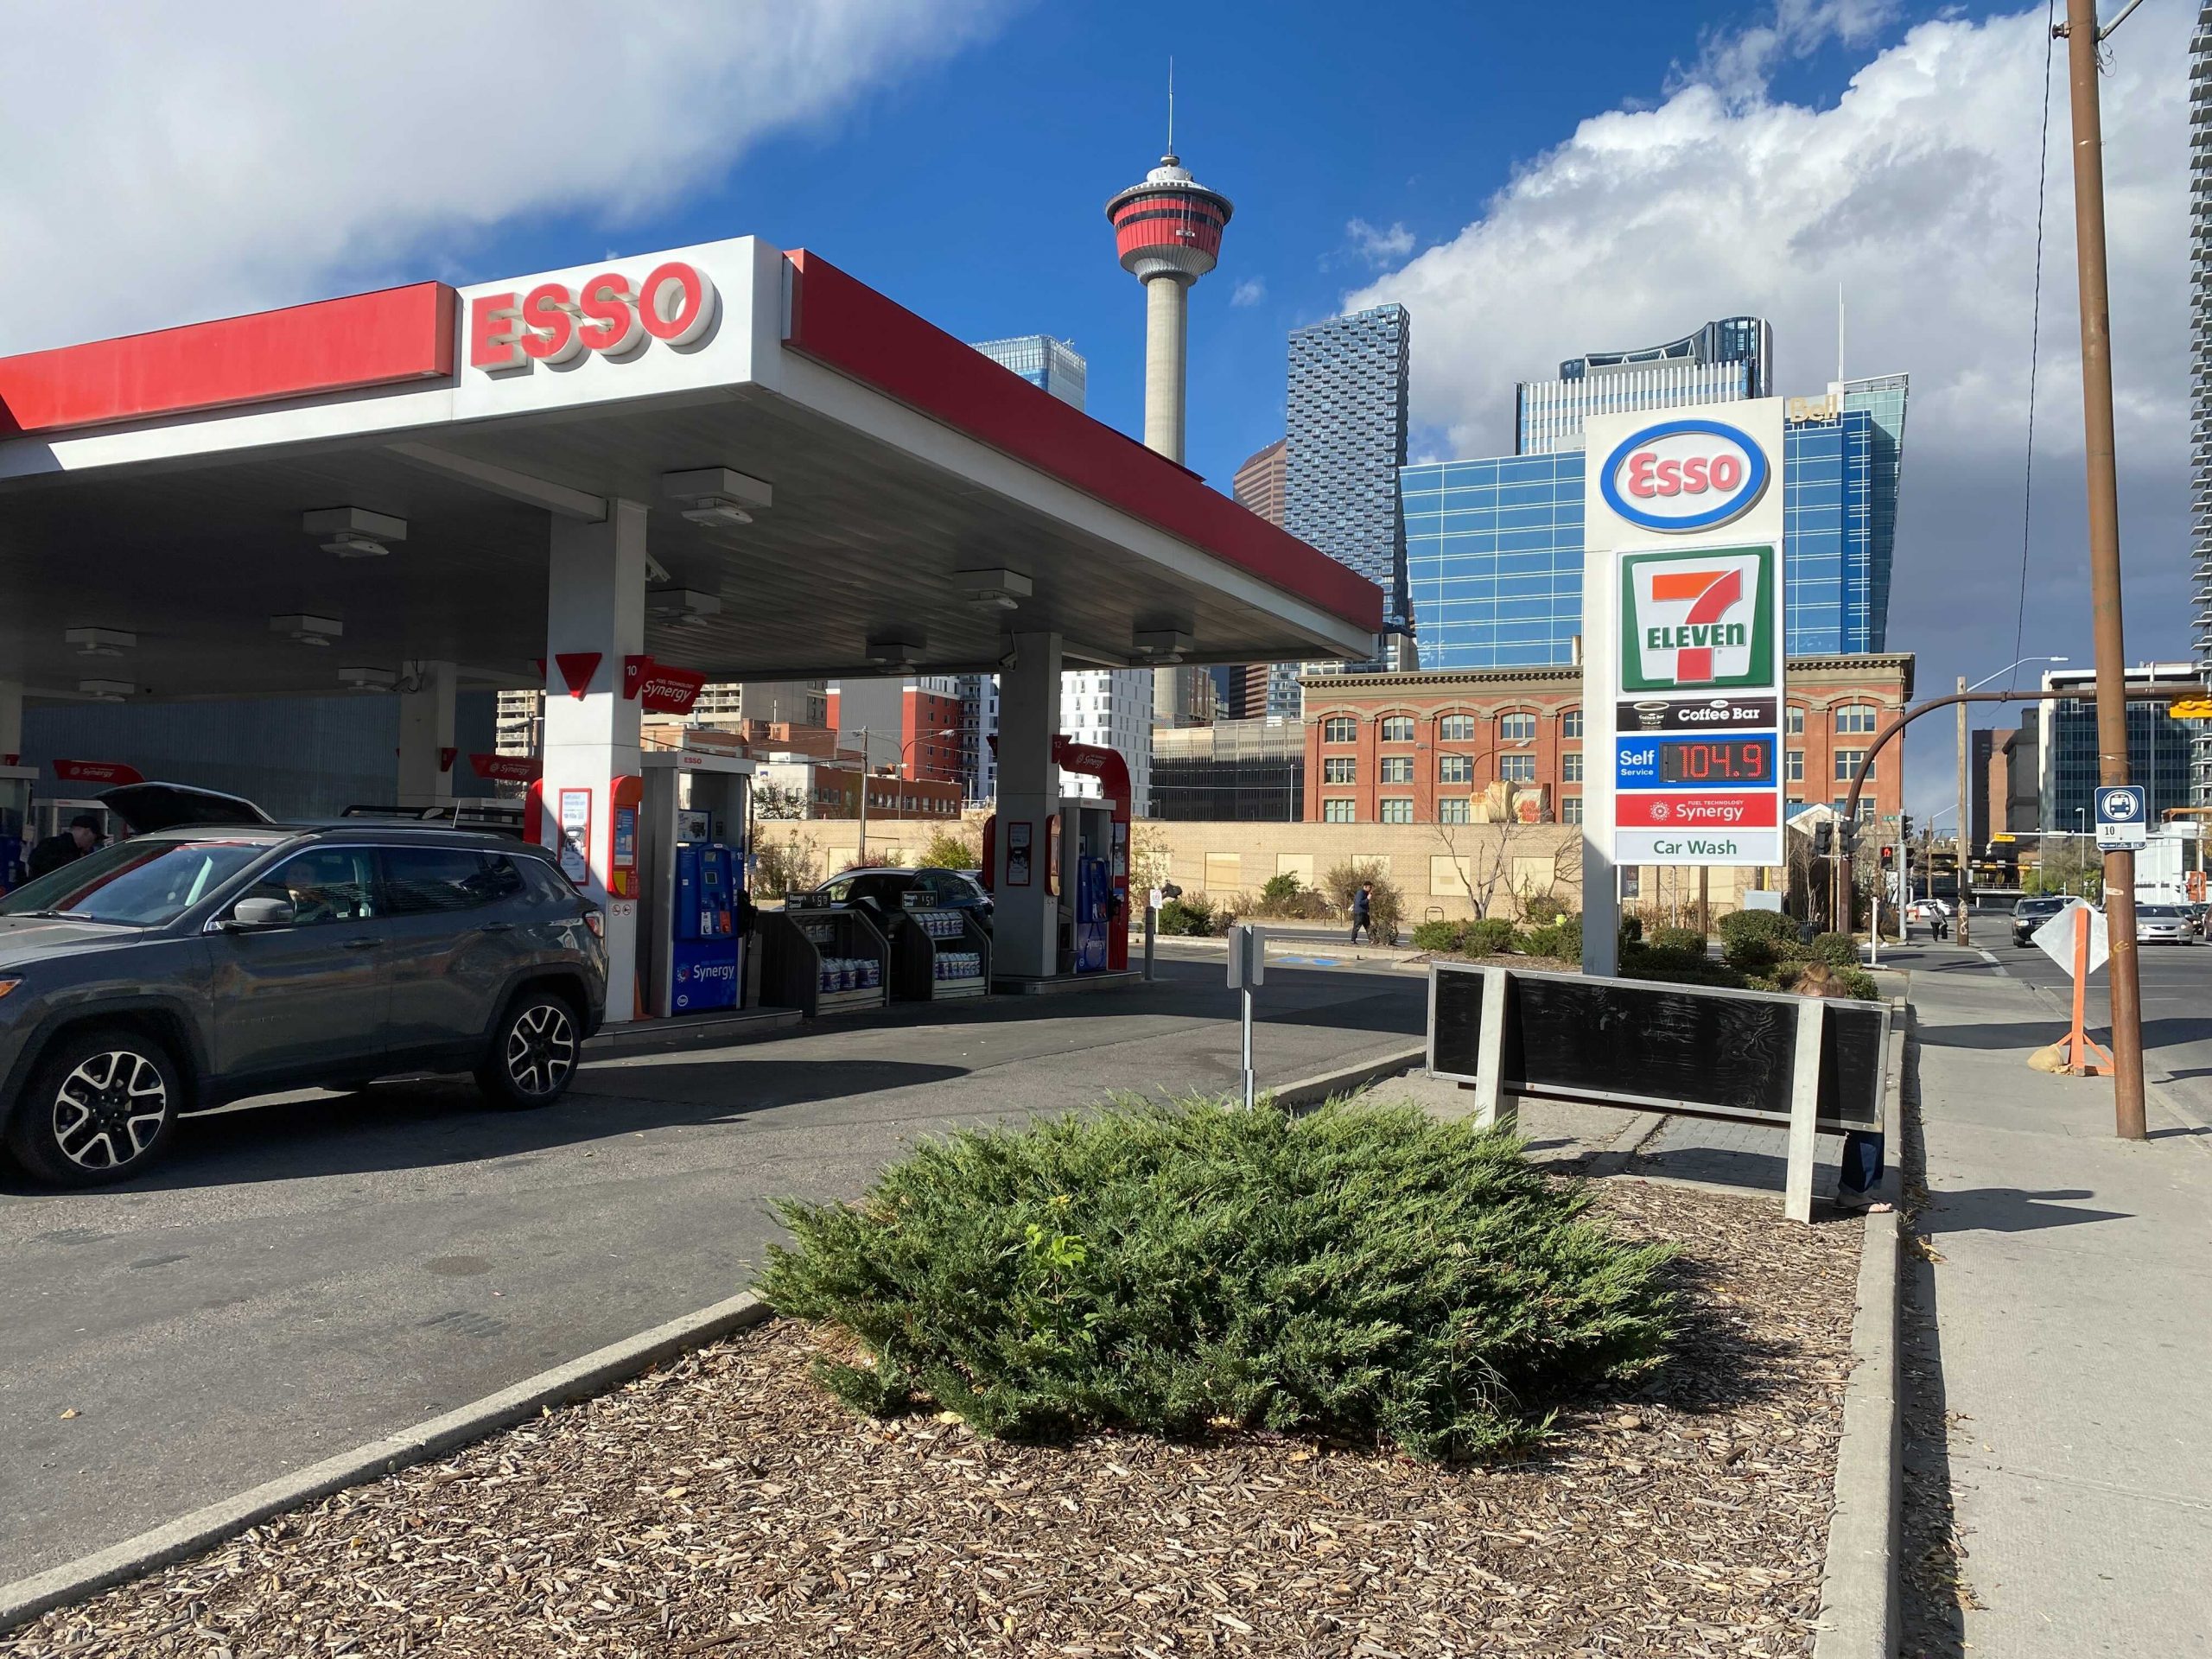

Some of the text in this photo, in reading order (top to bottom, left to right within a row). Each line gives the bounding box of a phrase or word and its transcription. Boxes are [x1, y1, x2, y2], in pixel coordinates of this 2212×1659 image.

[471, 262, 712, 370] ESSO
[1789, 393, 1839, 423] Bell
[626, 664, 637, 677] 10
[643, 680, 691, 702] Synergy
[1678, 708, 1761, 721] Coffee Bar
[1620, 750, 1655, 766] Self
[1678, 744, 1762, 777] 104.9
[1676, 804, 1744, 822] Synergy
[2105, 826, 2115, 836] 10
[1653, 839, 1737, 855] Car Wash
[737, 851, 744, 861] 10
[693, 964, 734, 982] Synergy
